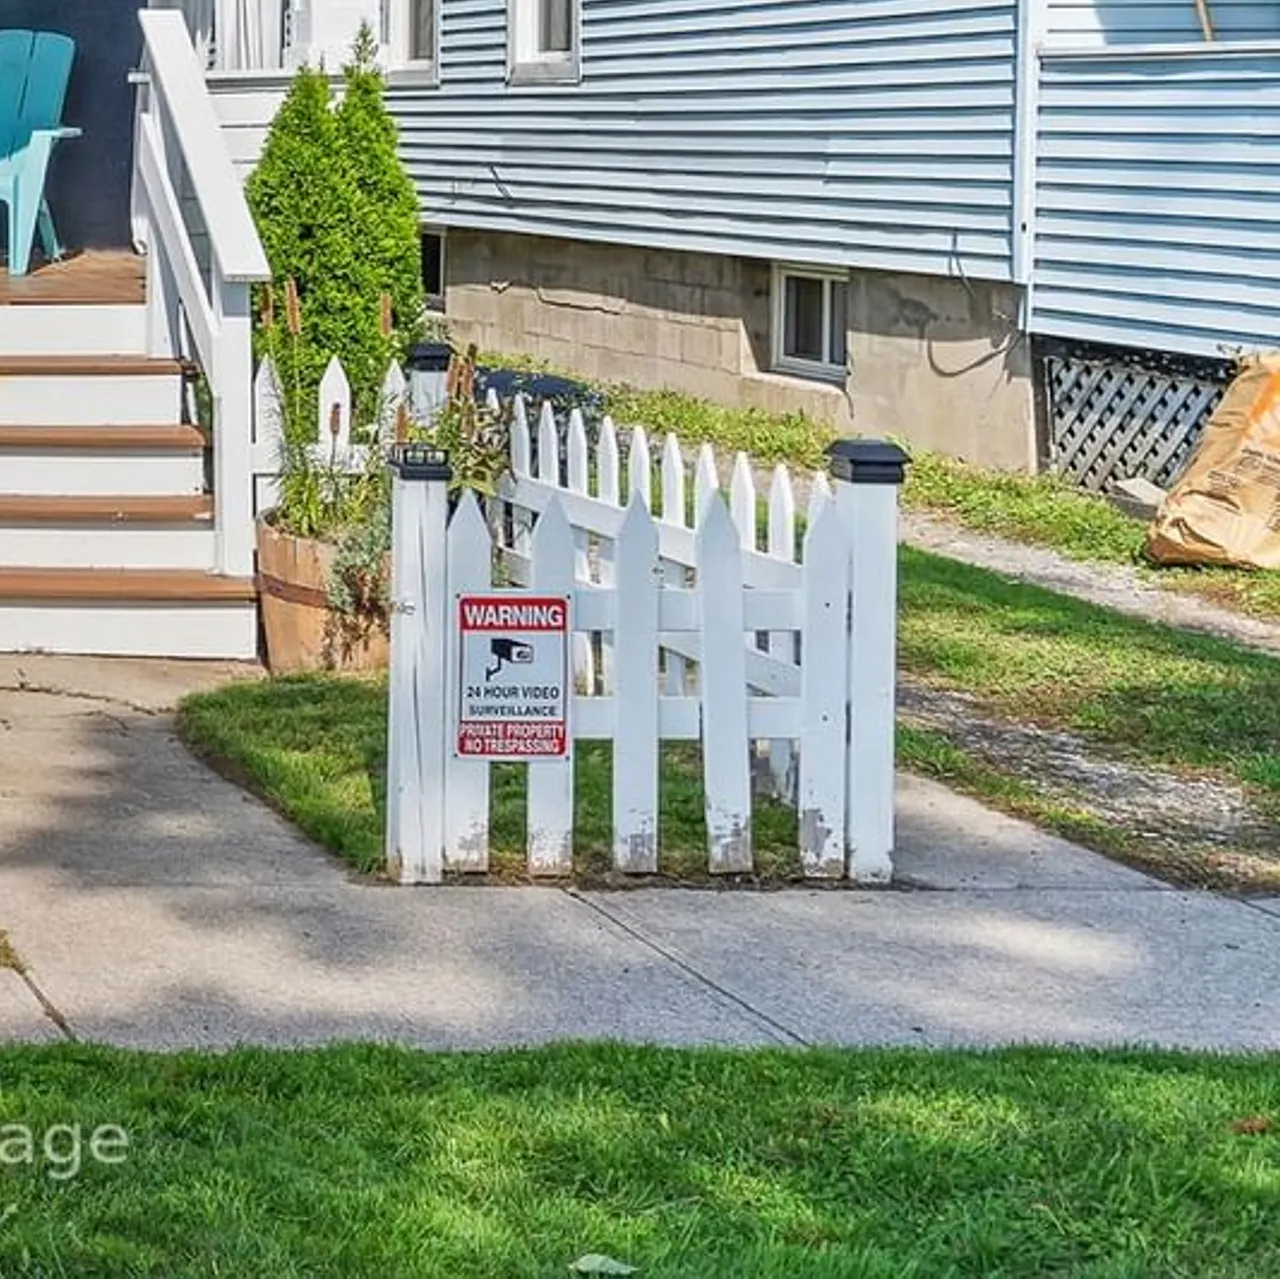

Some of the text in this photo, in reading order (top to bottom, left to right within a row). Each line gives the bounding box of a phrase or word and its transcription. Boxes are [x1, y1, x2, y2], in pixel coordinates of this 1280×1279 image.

[463, 604, 564, 628] WARNING
[466, 685, 560, 700] 24 HOUR VIDEO
[468, 704, 557, 717] SURVEILLANCE
[460, 723, 564, 739] PRIVATE PROPERTY
[464, 738, 560, 753] NO TRESPASSING
